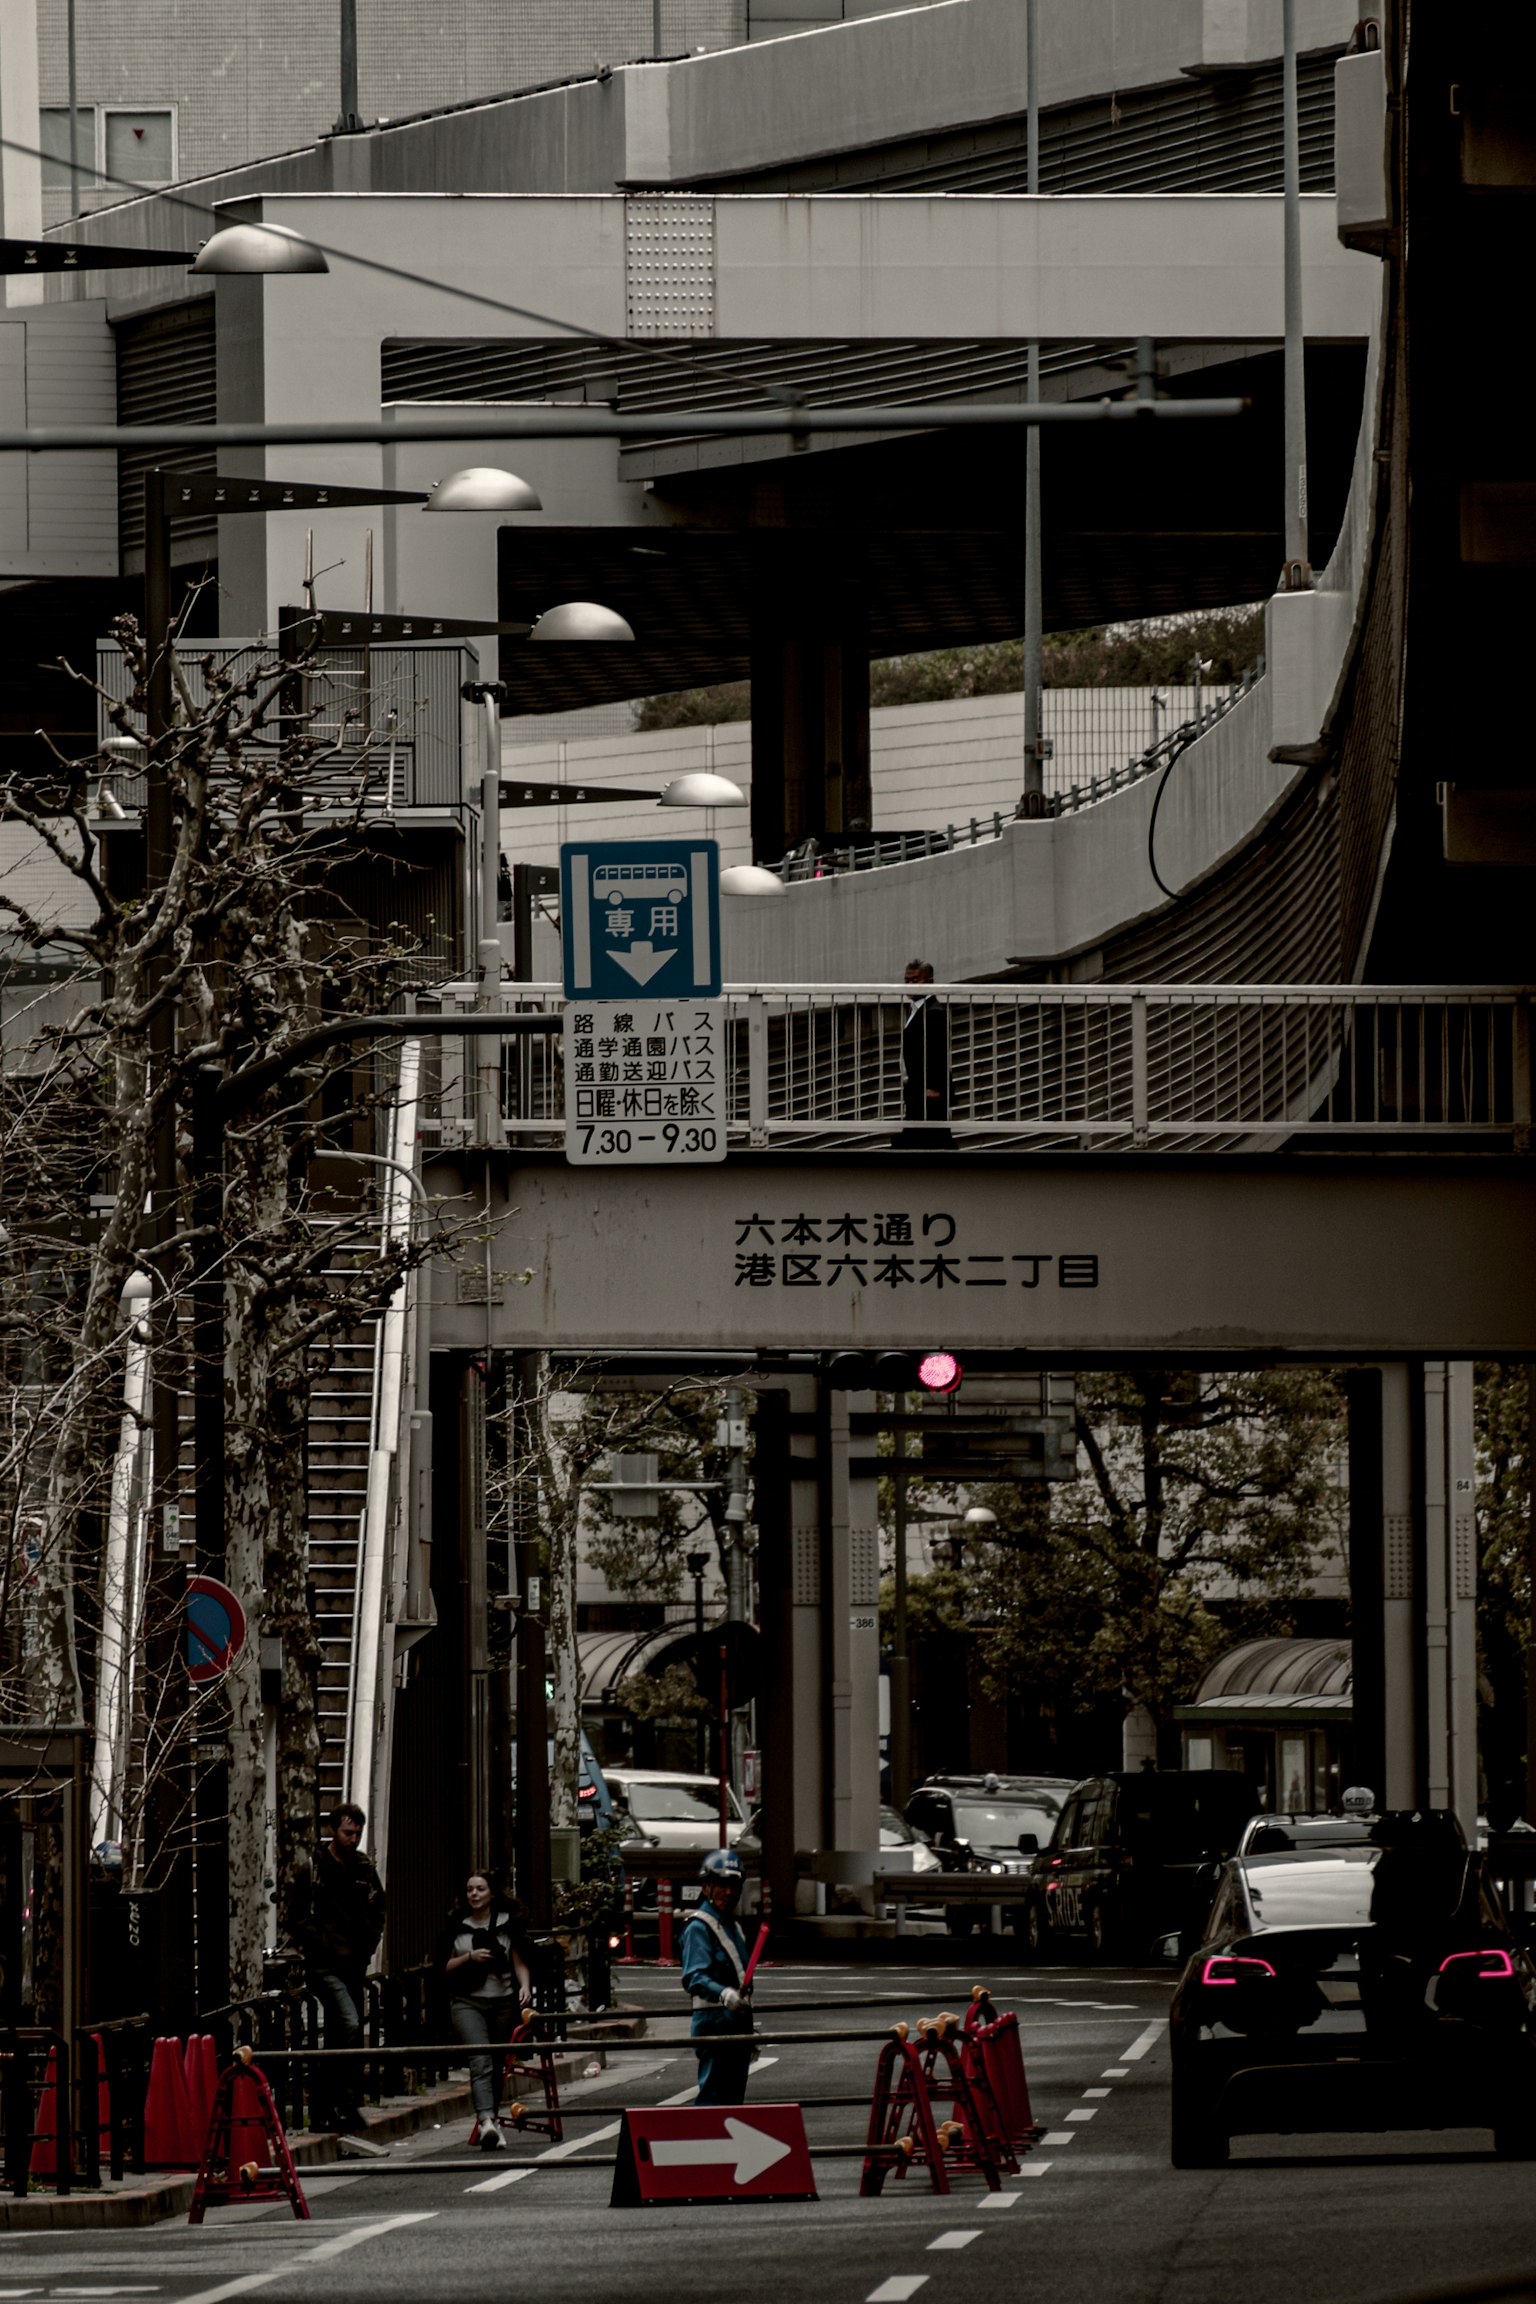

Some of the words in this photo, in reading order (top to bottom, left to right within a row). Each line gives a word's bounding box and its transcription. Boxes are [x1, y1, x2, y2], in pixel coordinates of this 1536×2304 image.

[605, 906, 679, 938] 専用
[573, 1012, 714, 1034] 路線バス
[573, 1036, 715, 1059] 通学通園バス
[574, 1060, 716, 1083] 通勤送迎バス
[735, 1213, 957, 1247] 六本木通り
[735, 1253, 1100, 1289] 港区六本木二丁目
